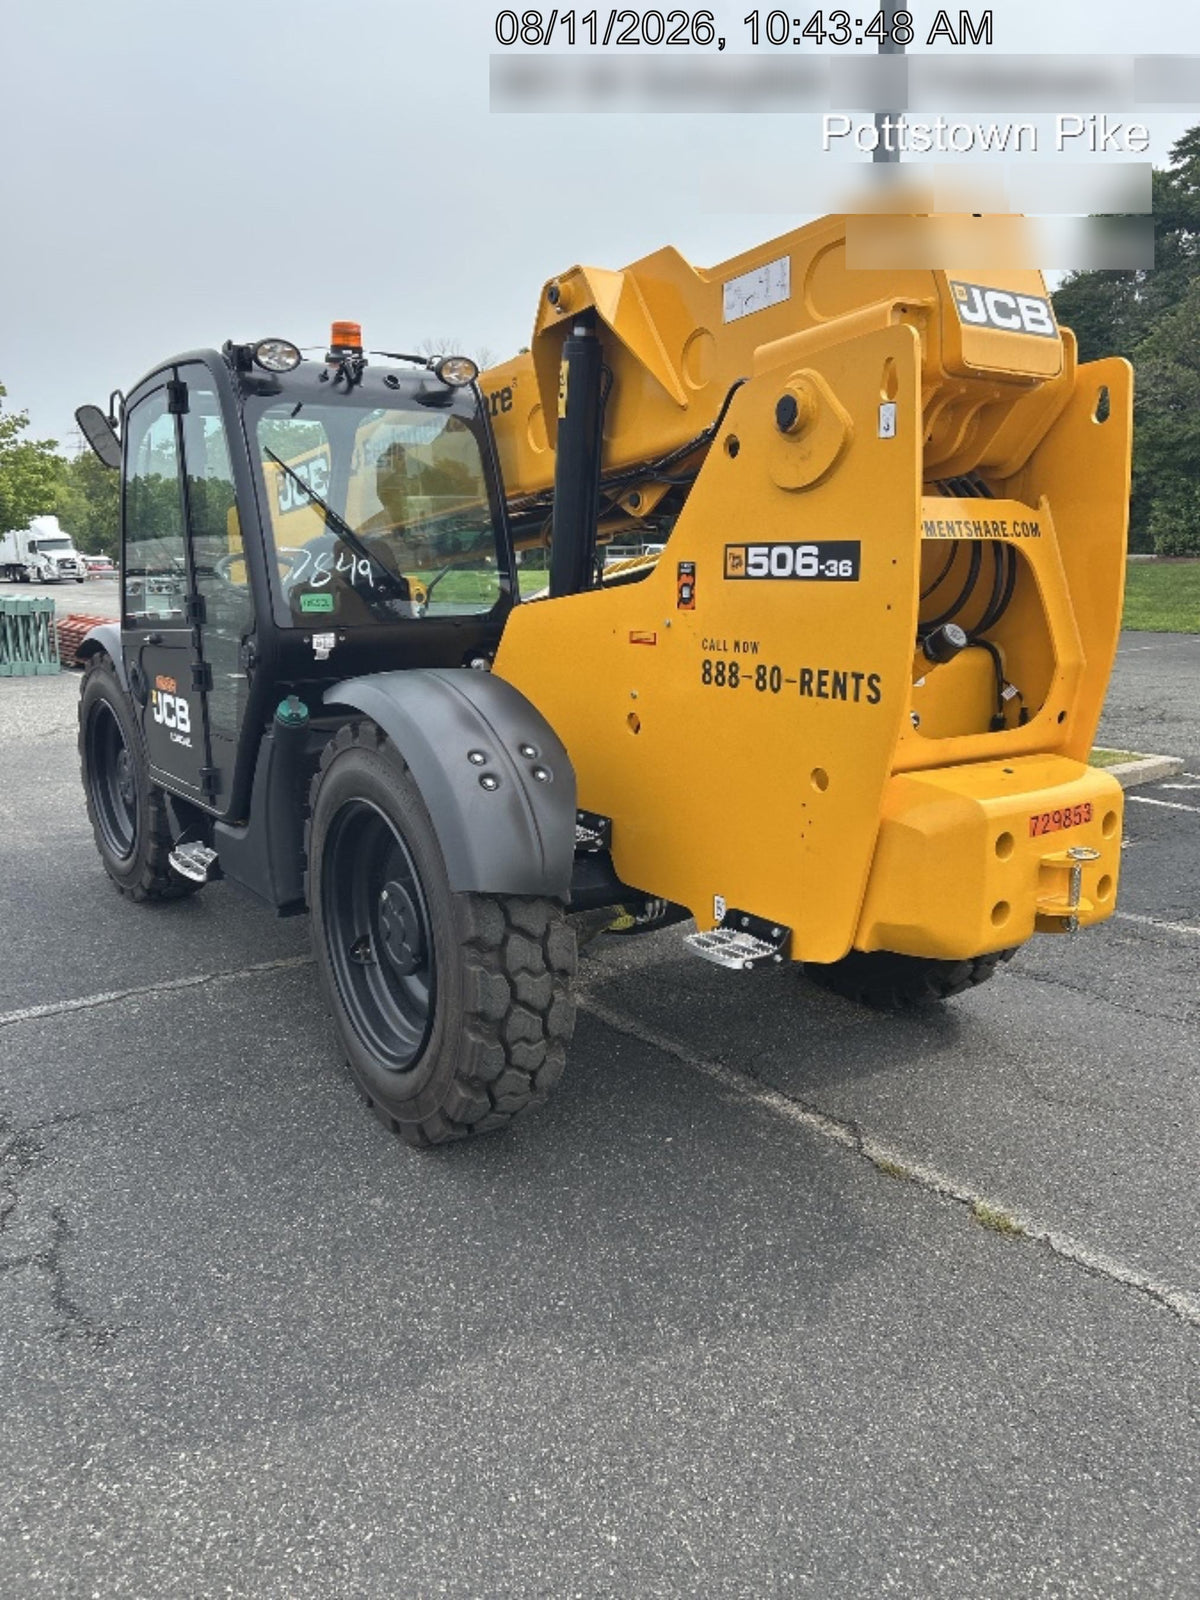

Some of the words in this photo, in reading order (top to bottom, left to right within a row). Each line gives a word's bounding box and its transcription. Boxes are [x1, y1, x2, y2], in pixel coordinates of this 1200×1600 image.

[959, 287, 1054, 334] JCB
[921, 520, 1040, 538] MENTSHARE.COM
[279, 547, 374, 588] 7849
[701, 637, 729, 652] CALL
[734, 640, 760, 655] NOW
[701, 659, 882, 705] 888-80-RENTS
[153, 690, 191, 734] JCB
[1030, 802, 1092, 837] 729853
